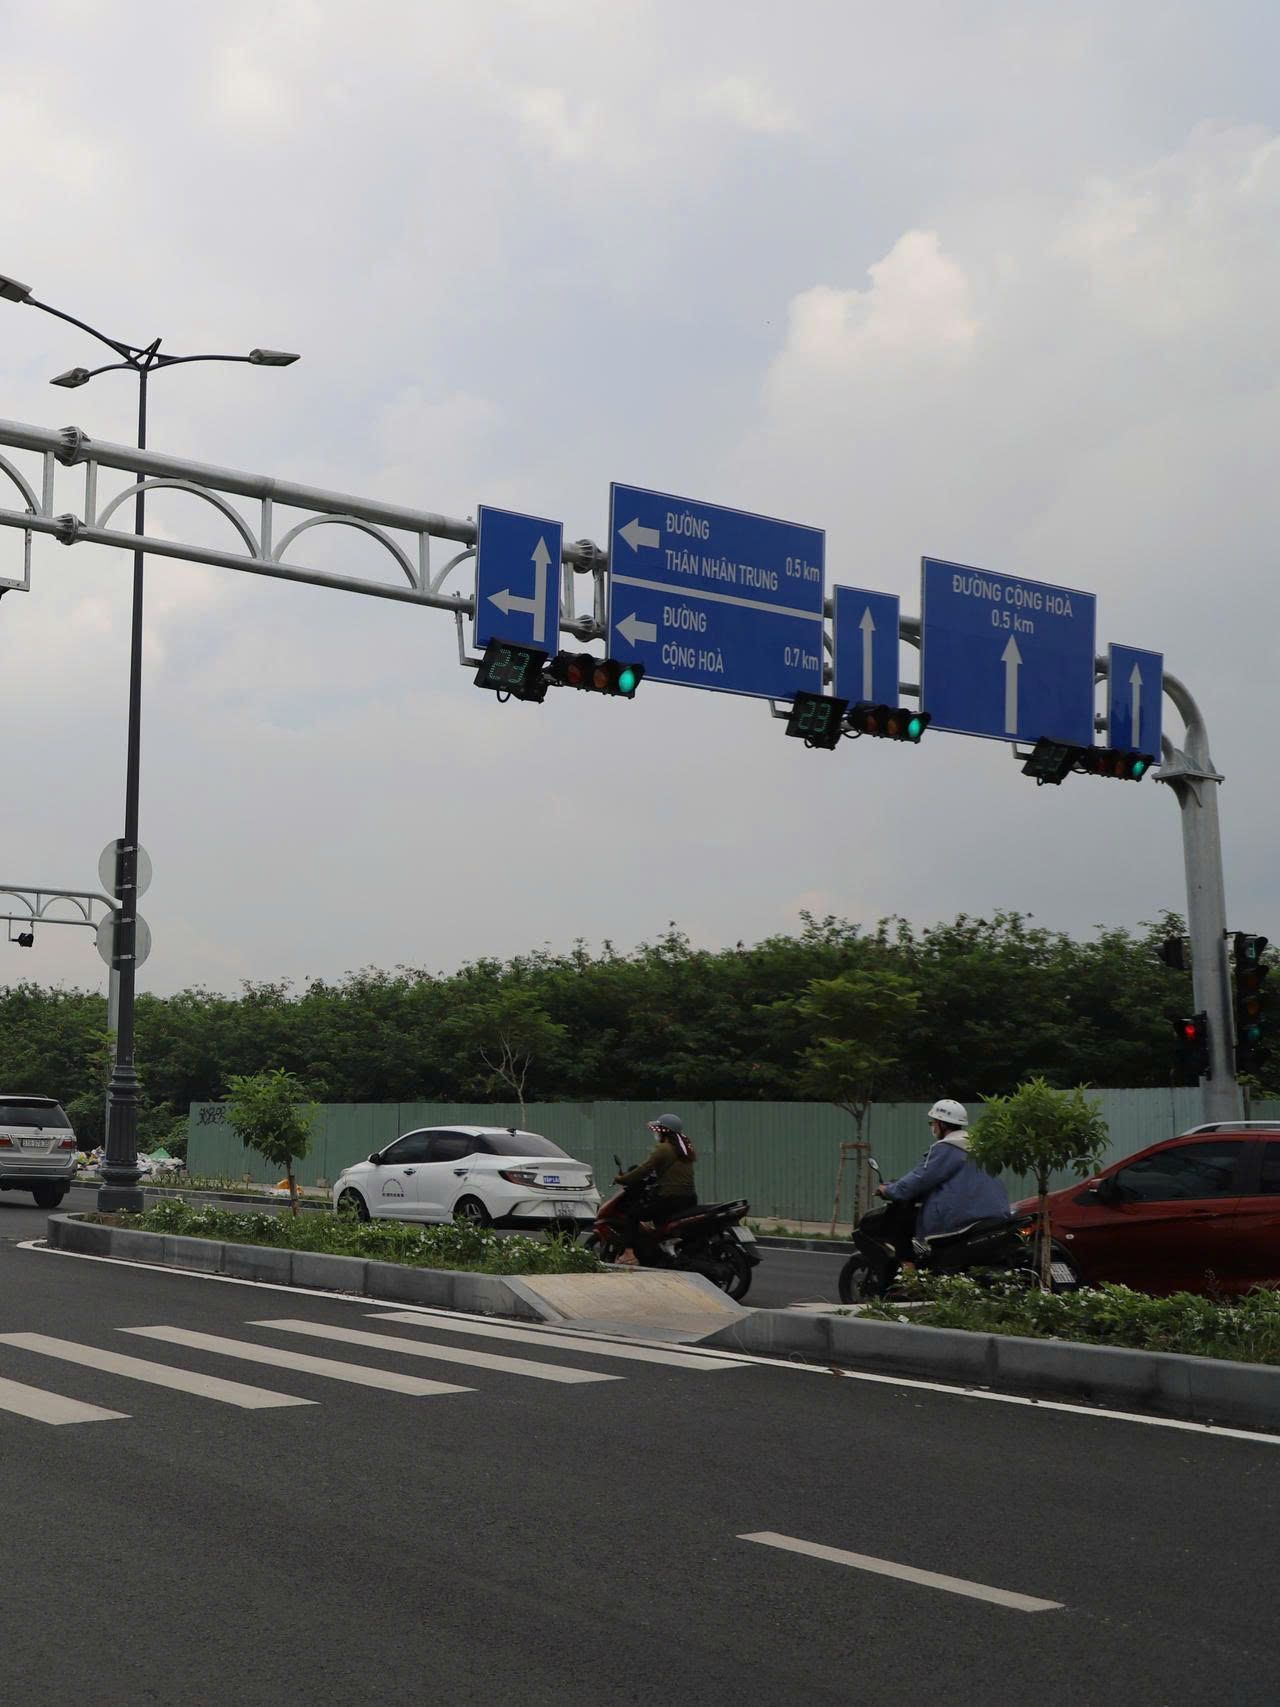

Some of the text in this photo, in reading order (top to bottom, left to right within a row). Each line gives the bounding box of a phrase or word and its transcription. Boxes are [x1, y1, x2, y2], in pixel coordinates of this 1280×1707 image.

[666, 510, 710, 540] ĐƯỜNG
[665, 548, 778, 591] THÂN NHÂN TRUNG
[785, 557, 820, 582] 0.5 km
[952, 573, 1073, 617] ĐƯỜNG CỘNG HOÀ
[664, 603, 707, 633] ĐƯỜNG
[991, 609, 1035, 634] 0.5 km
[489, 648, 530, 684] 23
[662, 641, 724, 674] CỘNG HOÀ
[784, 646, 819, 671] 0.7 km
[798, 700, 831, 732] 23
